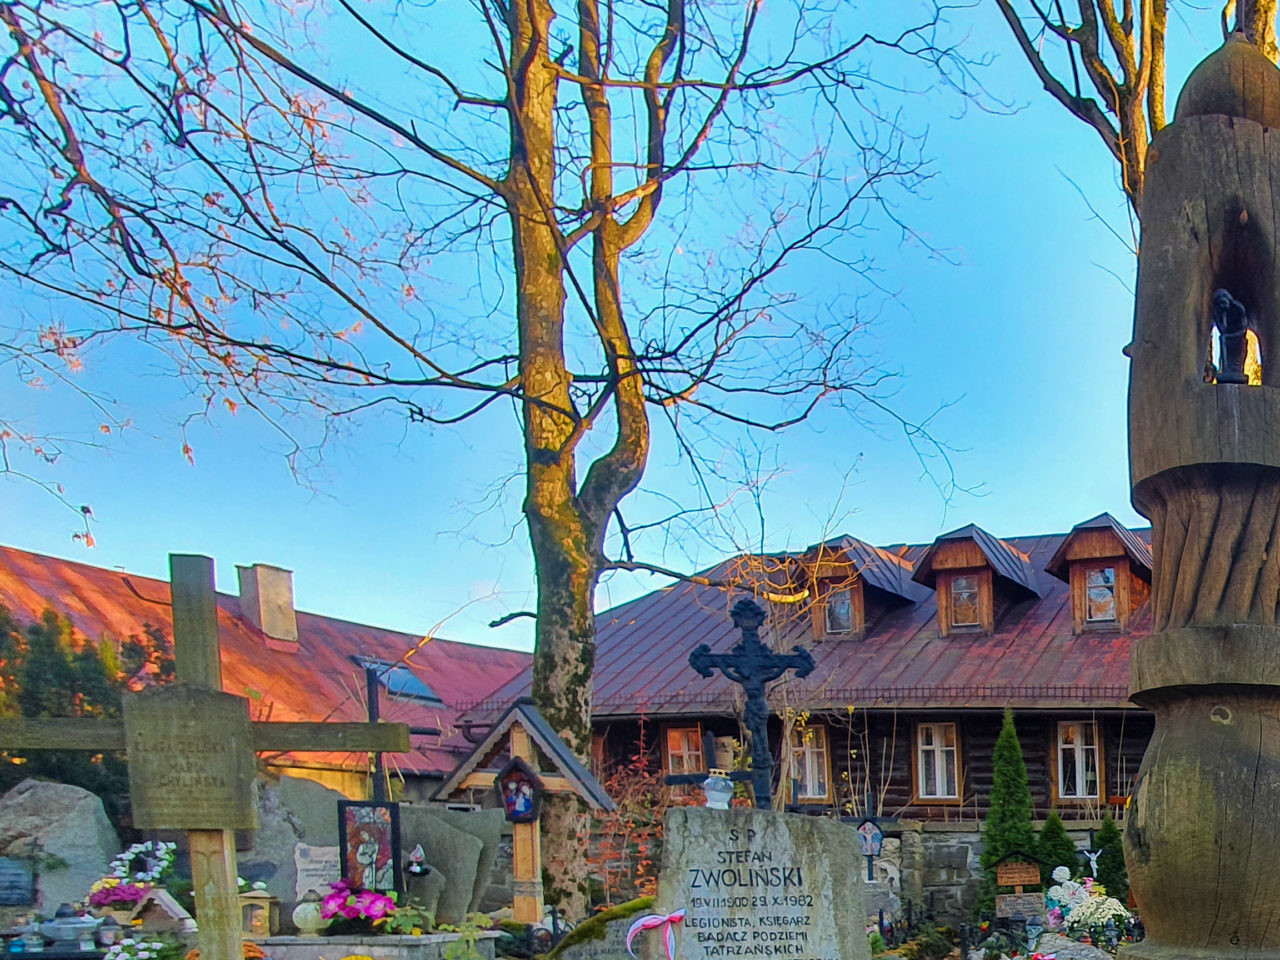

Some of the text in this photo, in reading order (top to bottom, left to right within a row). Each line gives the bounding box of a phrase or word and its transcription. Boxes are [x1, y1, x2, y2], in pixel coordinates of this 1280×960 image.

[717, 850, 772, 864] STEFAN
[689, 864, 803, 888] ZWOLIŃSKI
[697, 930, 808, 943] BADACZ PODZIEMI
[703, 942, 804, 957] TATRZAŃSKICH
